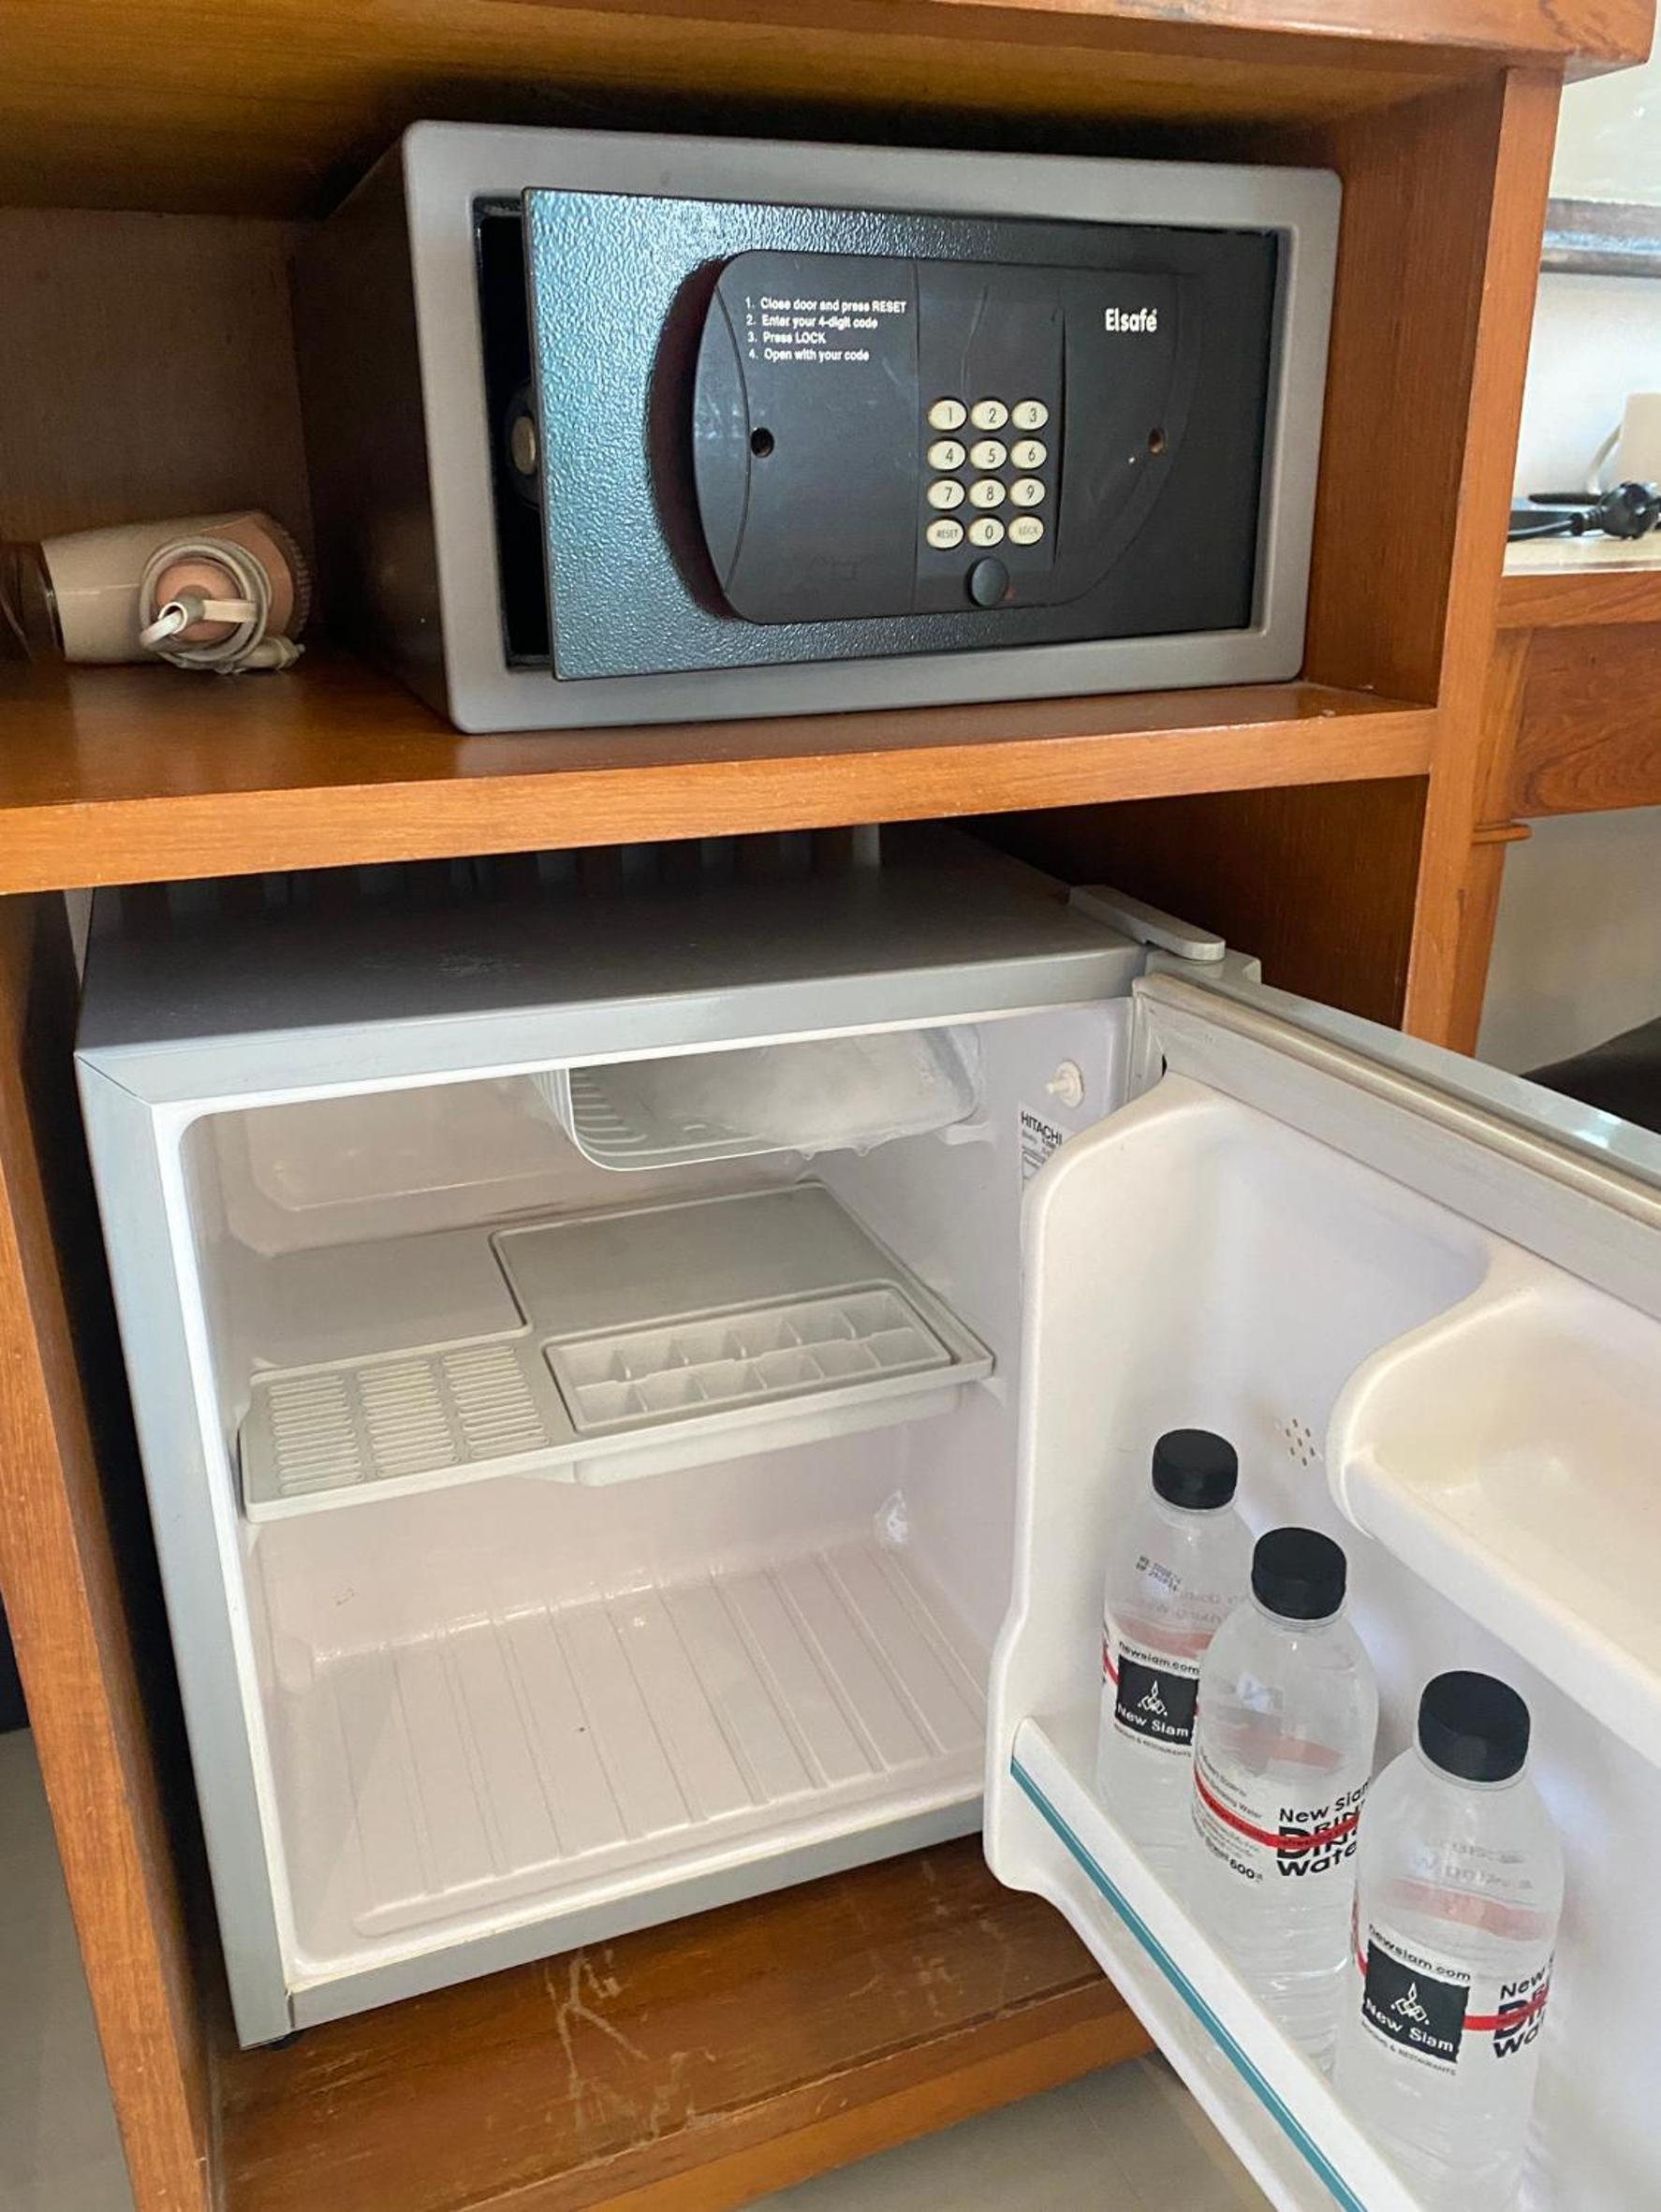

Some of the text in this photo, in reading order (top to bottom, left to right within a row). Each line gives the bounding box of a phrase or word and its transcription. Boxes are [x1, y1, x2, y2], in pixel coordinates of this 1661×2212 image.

[760, 297, 791, 311] Close
[793, 298, 817, 311] door
[819, 299, 840, 312] and
[842, 301, 870, 315] press
[872, 300, 906, 314] RESET
[761, 314, 790, 327] Enter
[792, 316, 816, 330] your
[818, 315, 851, 330] 4-digit
[853, 316, 878, 329] code
[1106, 307, 1157, 332] Elsafé
[763, 331, 793, 344] Press
[796, 331, 827, 344] LOCK
[764, 347, 792, 361] Open
[794, 347, 816, 360] with
[818, 351, 842, 363] your
[844, 348, 870, 361] code
[989, 407, 997, 423] 2
[1029, 407, 1038, 423] 3
[946, 447, 1036, 463] 4 5 6
[945, 484, 1035, 502] 7 8 9
[985, 525, 994, 540] 0
[1021, 1110, 1063, 1146] HITACHI
[1118, 1703, 1147, 1726] New
[1151, 1720, 1189, 1737] Siam
[1279, 1806, 1330, 1824] New
[1229, 1858, 1256, 1880] 600
[1276, 1841, 1358, 1877] Wate
[1369, 1924, 1471, 1981] newsiam.com
[1499, 1967, 1545, 2000] New
[1366, 1998, 1404, 2032] New
[1409, 2027, 1454, 2053] Siam
[1493, 2023, 1540, 2058] Wa
